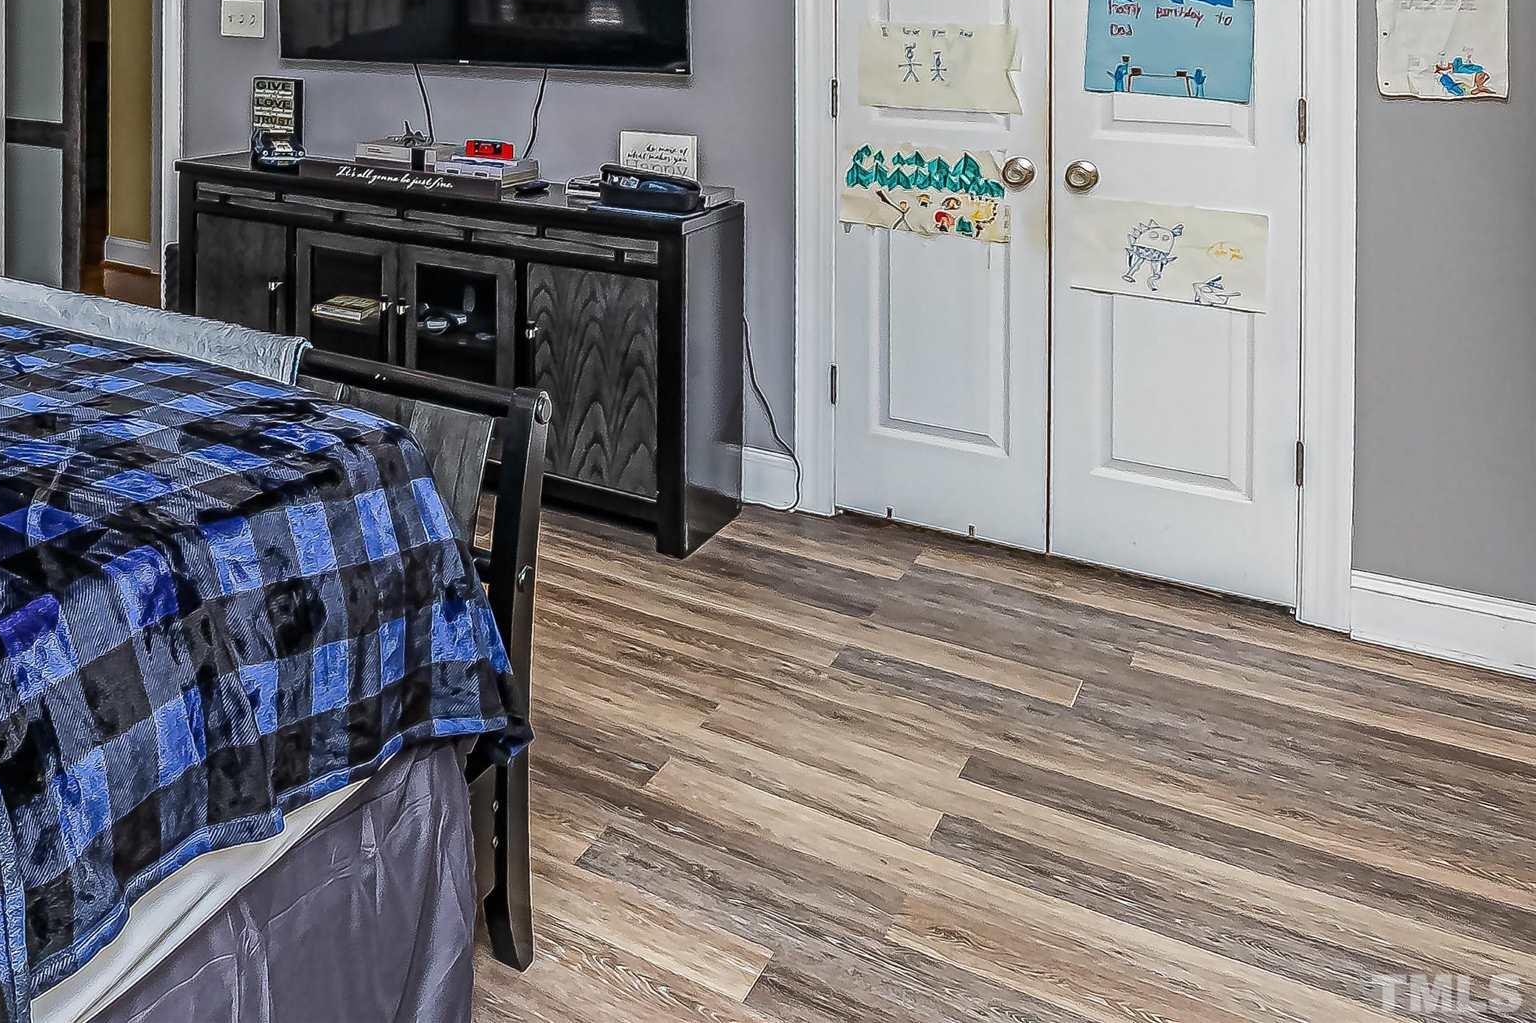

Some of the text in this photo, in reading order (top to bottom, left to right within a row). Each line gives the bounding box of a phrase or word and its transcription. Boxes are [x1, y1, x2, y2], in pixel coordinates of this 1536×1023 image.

[256, 80, 292, 91] GIVE
[255, 97, 292, 109] LOVE
[254, 114, 291, 126] TRUST
[336, 165, 356, 177] It's
[357, 169, 371, 179] all
[368, 174, 399, 184] gonna
[406, 177, 432, 189] just
